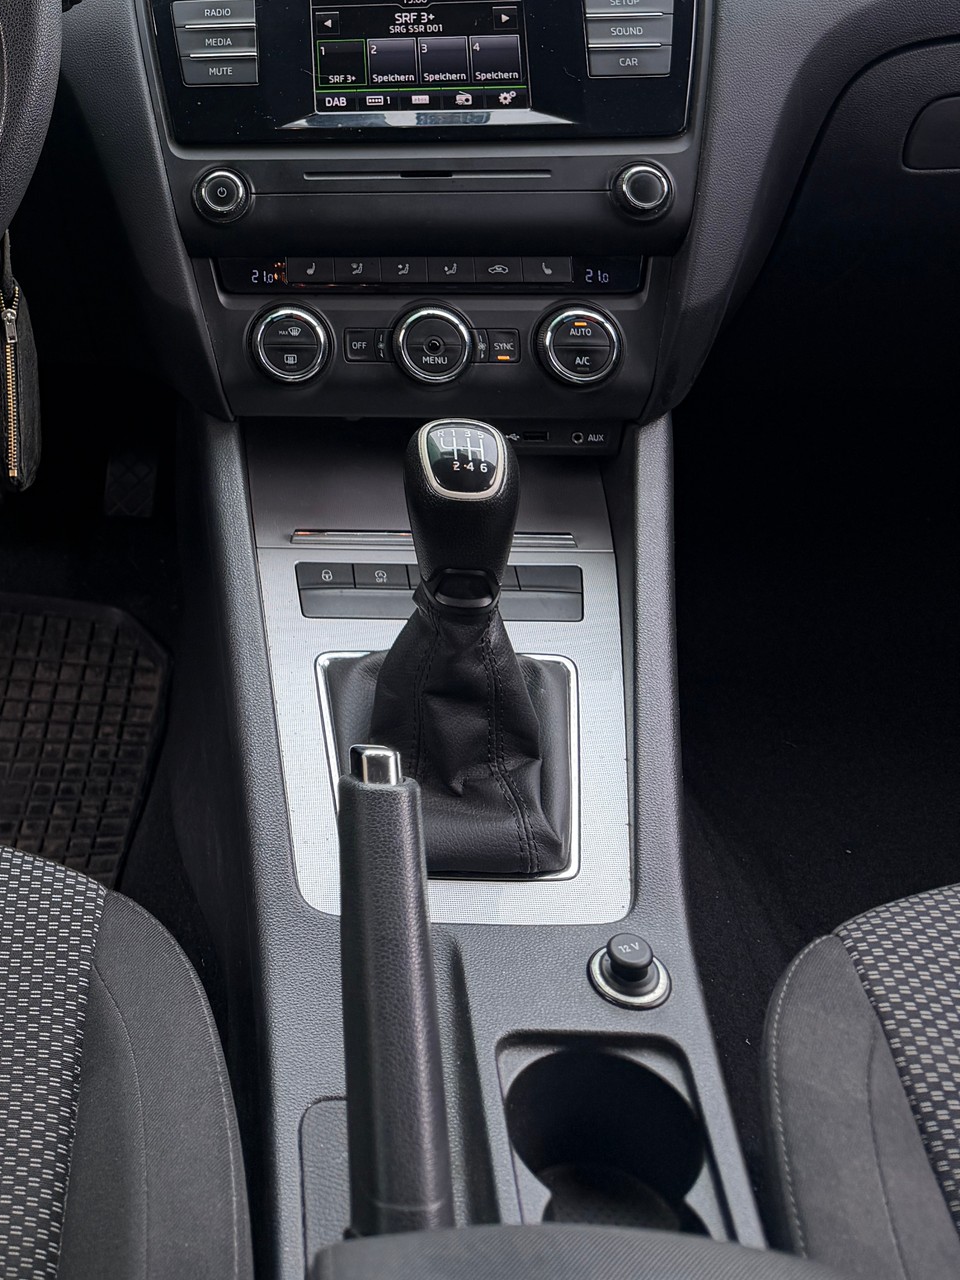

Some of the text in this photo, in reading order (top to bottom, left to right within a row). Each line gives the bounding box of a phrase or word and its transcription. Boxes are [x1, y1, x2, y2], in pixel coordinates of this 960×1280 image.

[204, 8, 231, 17] RADIO
[394, 12, 436, 24] SRF 3+
[389, 25, 407, 34] SRG
[408, 24, 425, 33] SSR
[610, 26, 643, 36] SOUND
[205, 38, 232, 47] MEDIA
[472, 42, 480, 51] 4
[320, 46, 325, 56] 1
[370, 45, 377, 54] 2
[421, 44, 428, 53] 3
[619, 57, 639, 66] CAR
[209, 67, 233, 76] MUTE
[475, 70, 519, 81] Speichern
[328, 74, 357, 83] SRF 3+
[372, 73, 415, 83] Speichern
[423, 72, 467, 82] Speichern
[325, 96, 347, 107] DAB
[386, 96, 391, 104] 1
[569, 328, 592, 336] AUTO
[351, 341, 368, 350] OFF
[493, 342, 514, 351] SYNC
[422, 356, 448, 365] MENU
[575, 356, 590, 366] A/C
[587, 433, 604, 442] AUX
[453, 461, 488, 473] 2 4 6
[618, 942, 640, 953] 12 V
